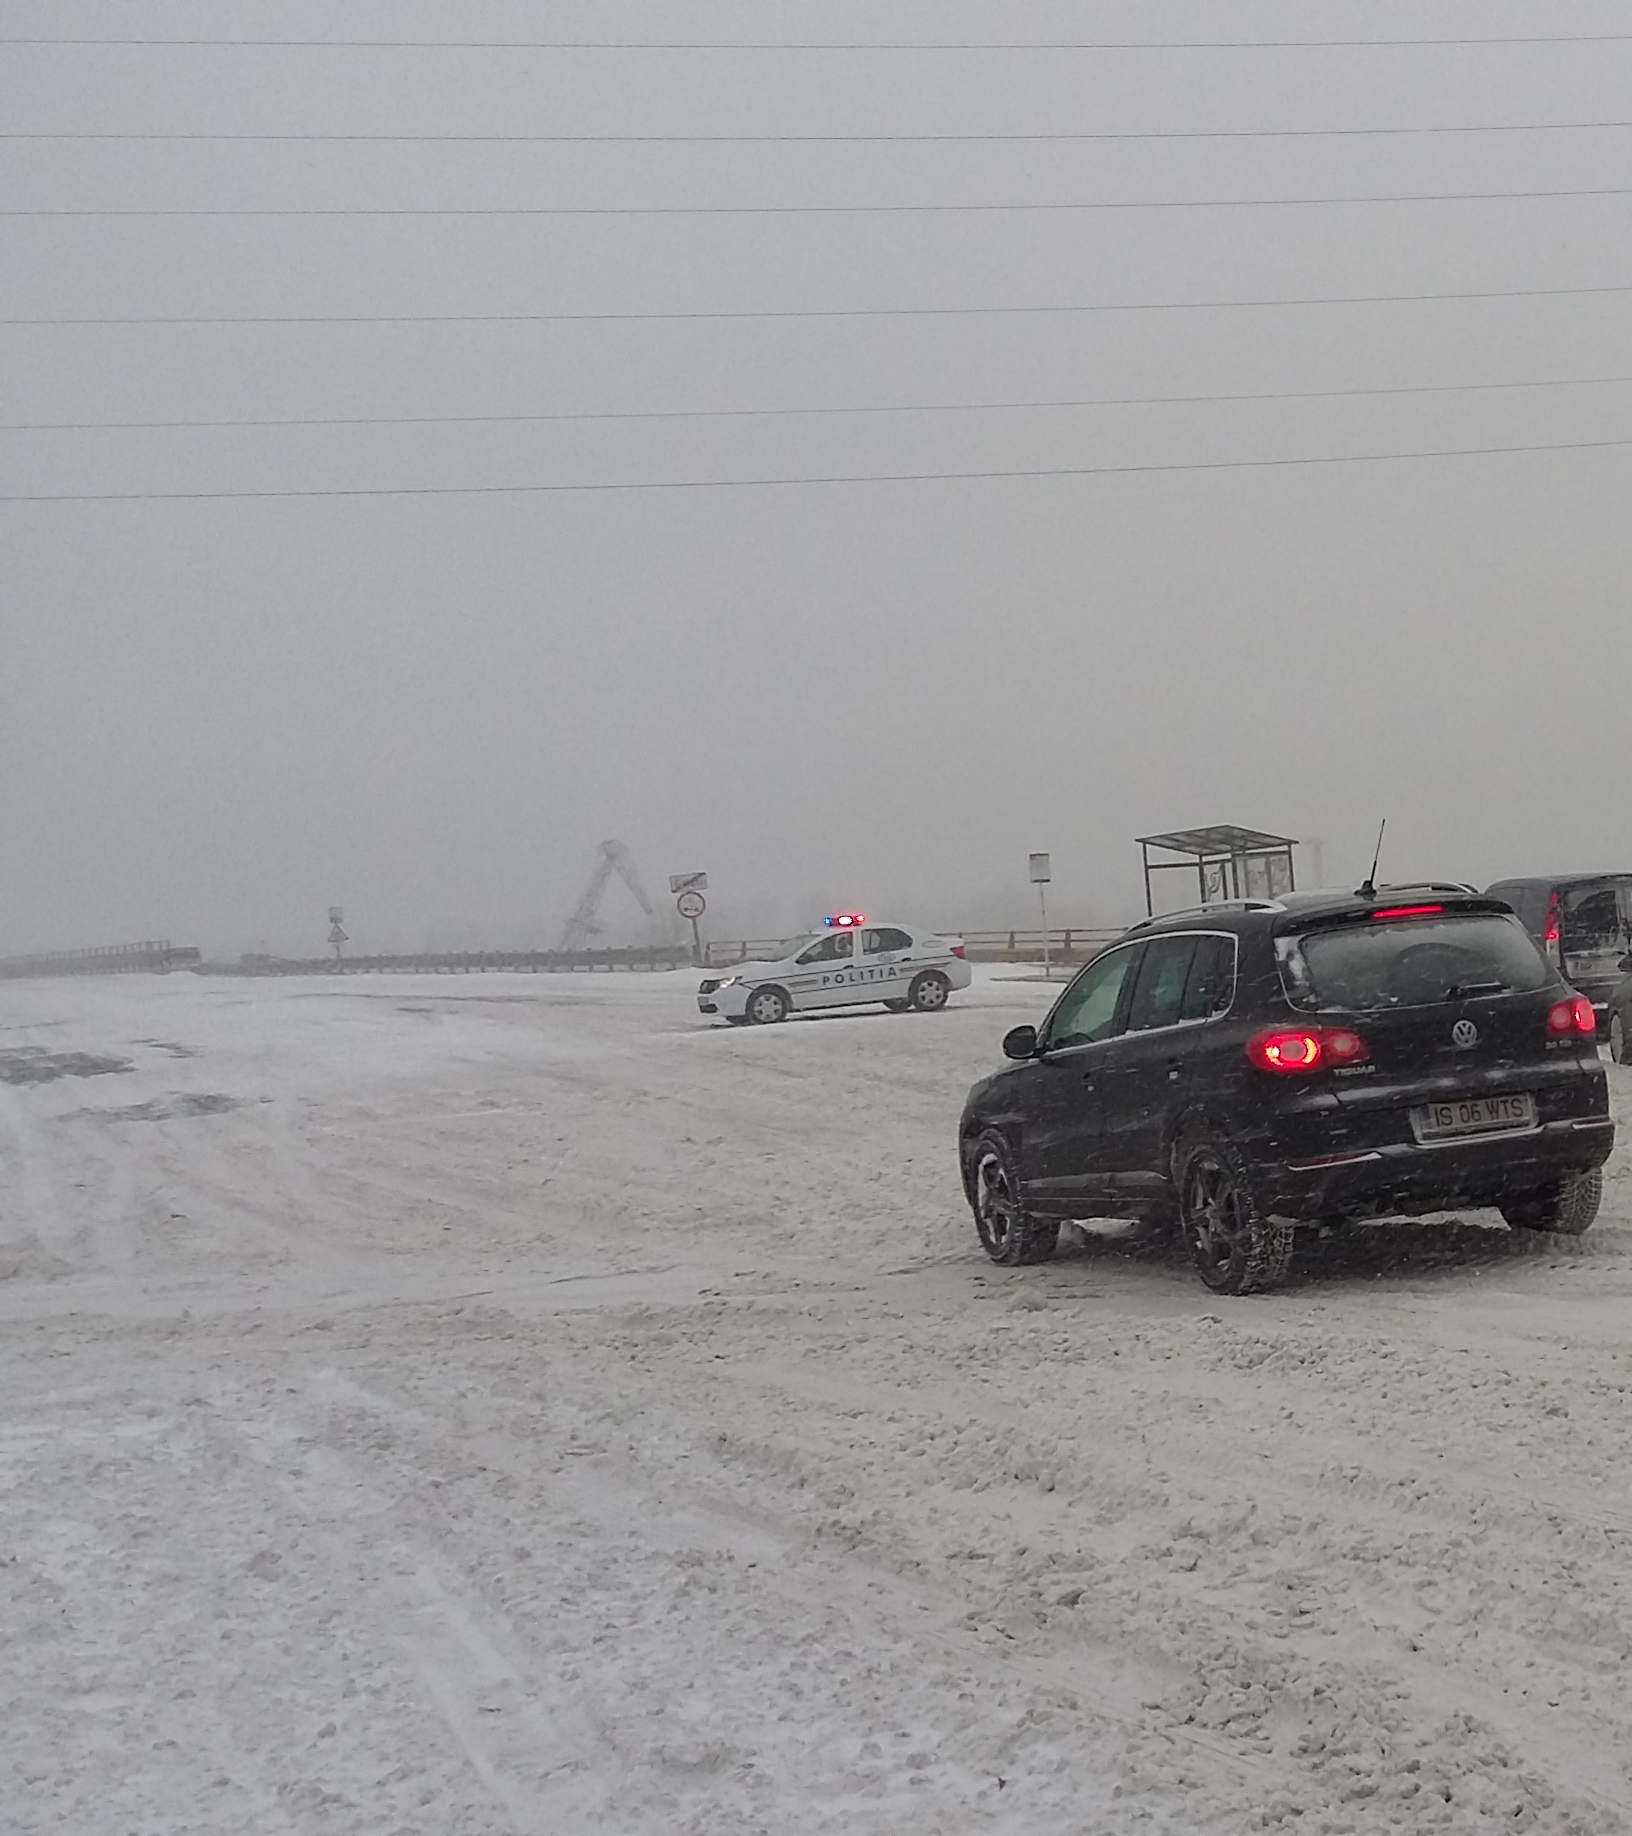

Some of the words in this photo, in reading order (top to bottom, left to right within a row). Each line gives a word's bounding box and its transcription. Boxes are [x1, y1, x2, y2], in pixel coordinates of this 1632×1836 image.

[1434, 1106, 1453, 1127] IS
[1459, 1103, 1481, 1123] 06
[1485, 1098, 1523, 1120] WTS
